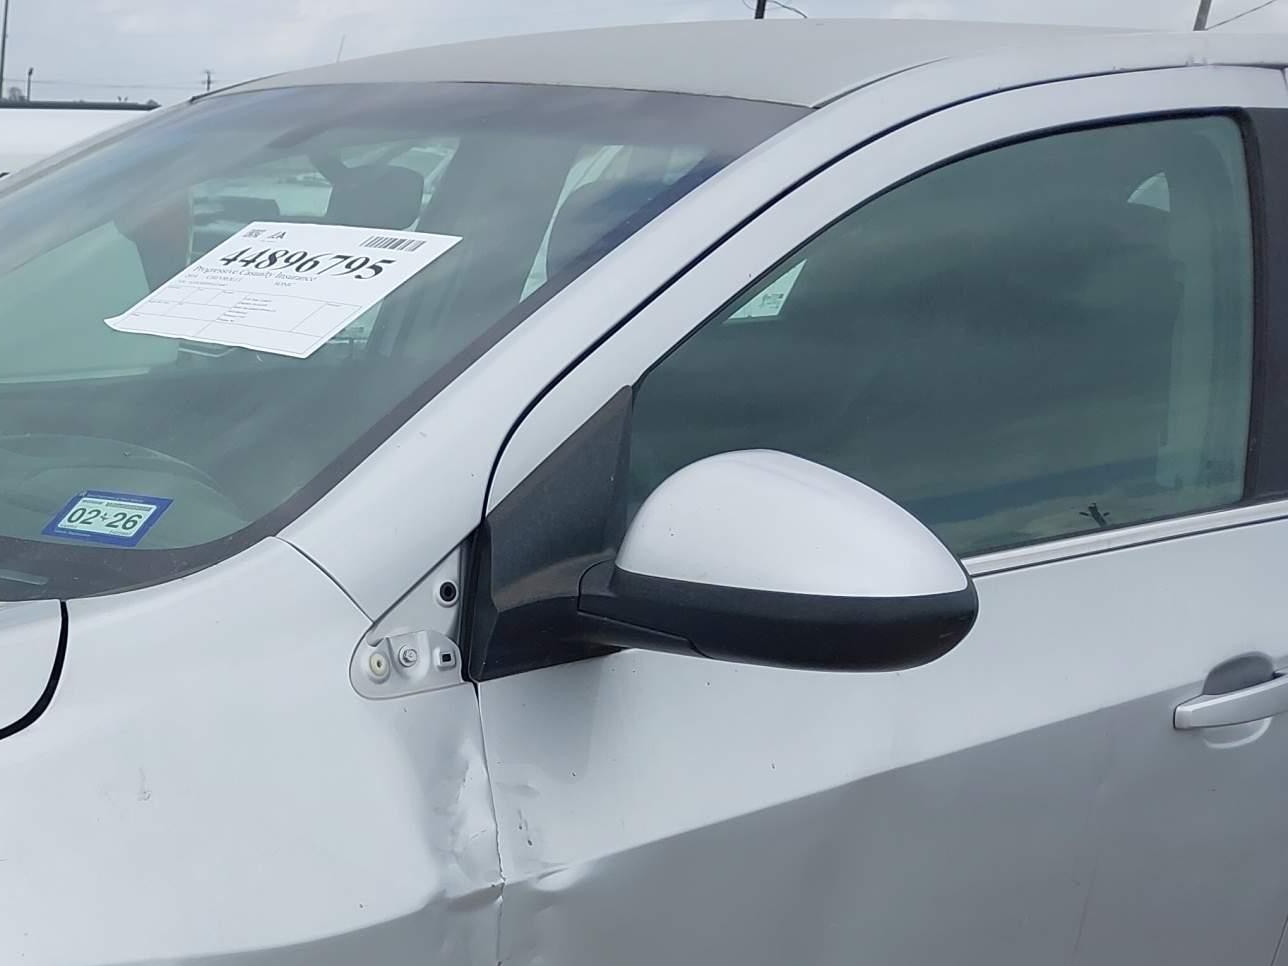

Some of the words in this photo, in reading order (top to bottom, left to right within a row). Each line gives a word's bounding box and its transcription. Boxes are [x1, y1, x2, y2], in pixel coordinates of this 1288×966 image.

[193, 265, 239, 277] Progressive
[275, 271, 318, 283] Insurance
[219, 247, 397, 280] 44896795
